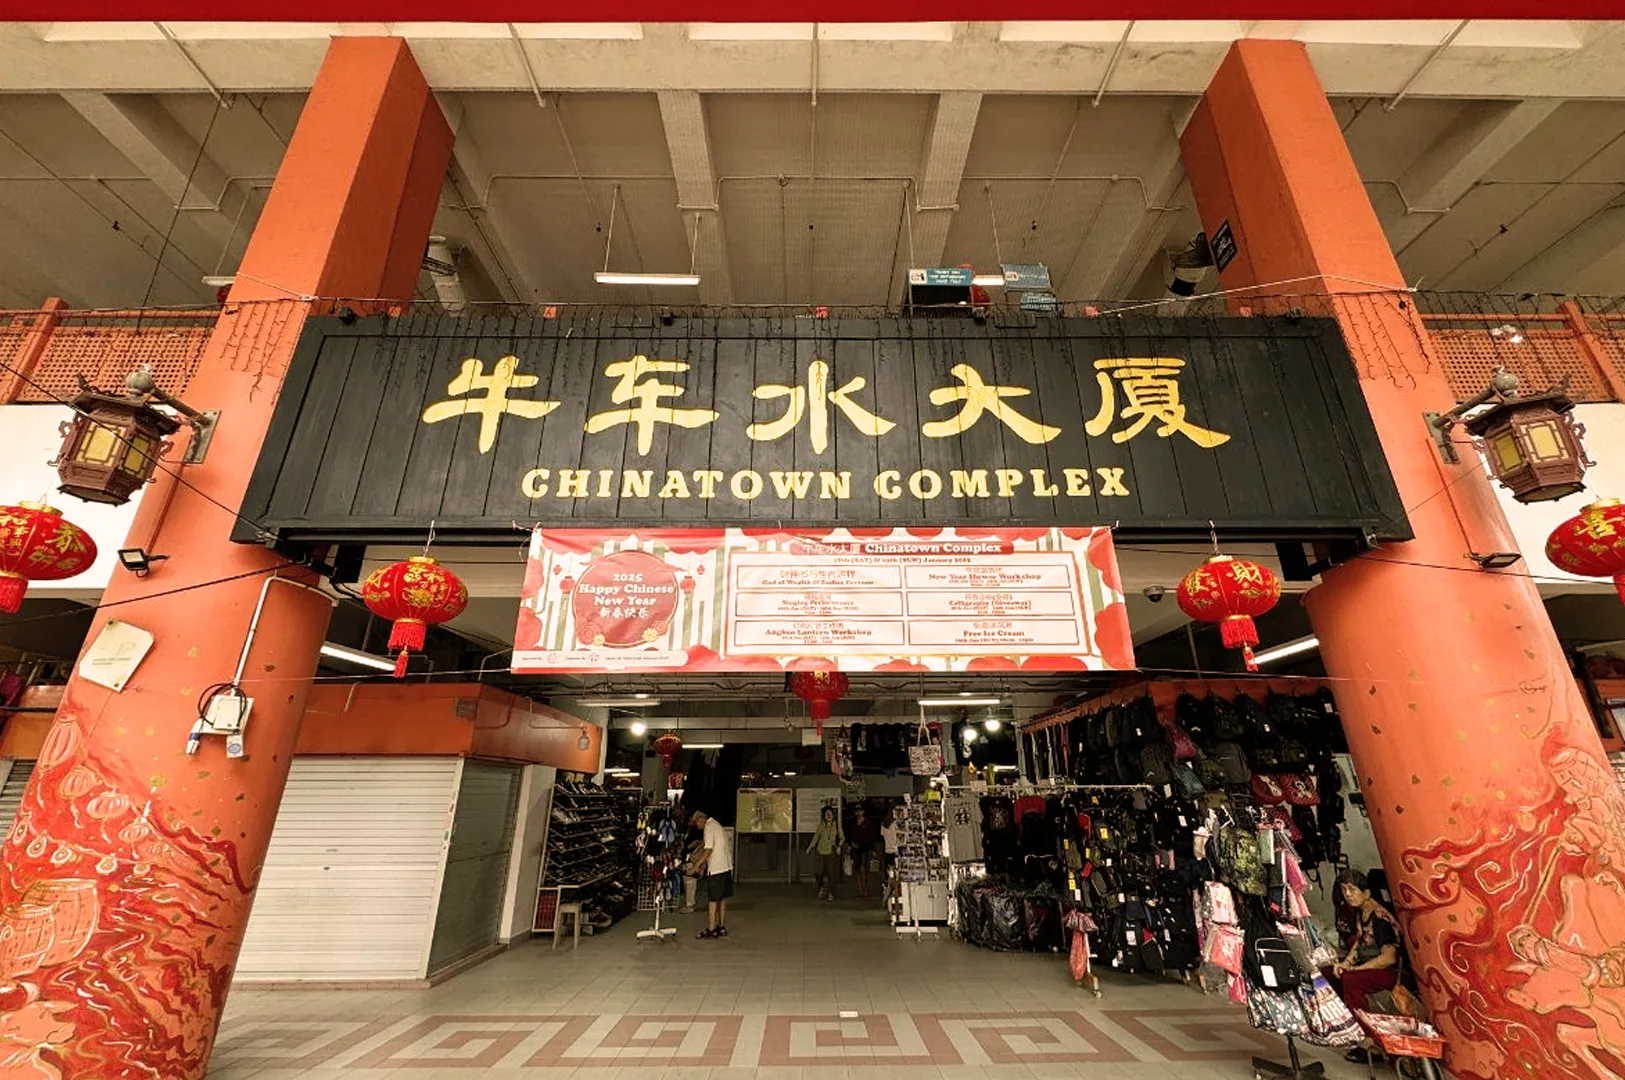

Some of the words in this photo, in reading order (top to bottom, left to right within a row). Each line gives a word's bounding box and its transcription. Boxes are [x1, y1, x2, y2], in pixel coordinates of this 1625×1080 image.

[422, 355, 1231, 455] 牛车水大厦
[521, 468, 851, 500] CHINATOWN
[873, 467, 1130, 499] COMPLEX
[865, 543, 940, 553] Chinatown
[943, 542, 1002, 555] Complex
[612, 573, 644, 583] 2025
[578, 584, 620, 595] Happy
[623, 584, 674, 594] Chinese
[593, 596, 625, 606] New
[626, 596, 657, 606] Year
